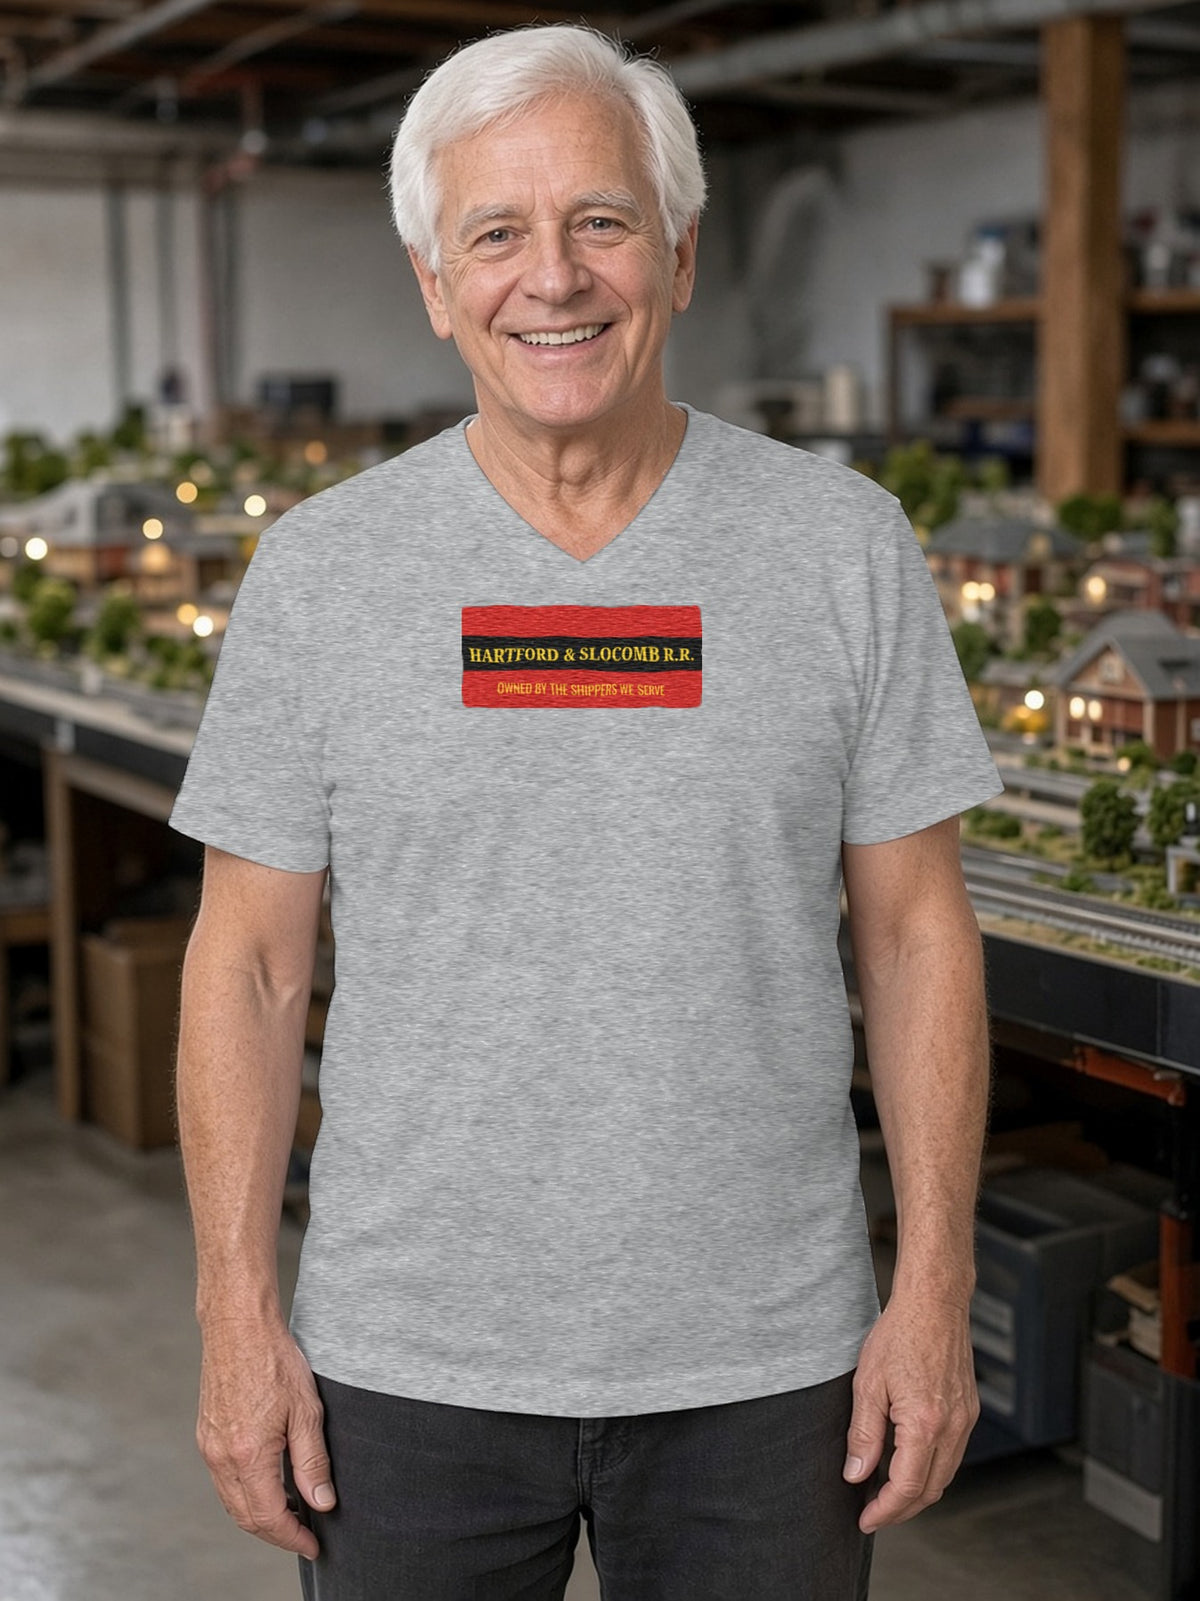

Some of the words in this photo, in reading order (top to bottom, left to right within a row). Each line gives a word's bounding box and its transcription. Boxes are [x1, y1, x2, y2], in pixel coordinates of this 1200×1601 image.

[469, 647, 559, 663] HARTFORD
[563, 647, 576, 662] &
[579, 646, 660, 663] SLOCOMB
[663, 647, 695, 662] R.R.
[497, 682, 533, 695] OWNED
[534, 682, 547, 695] BY
[550, 683, 568, 696] THE
[570, 684, 618, 697] SHIPPERS
[620, 684, 634, 696] WE
[637, 684, 665, 696] SERVE
